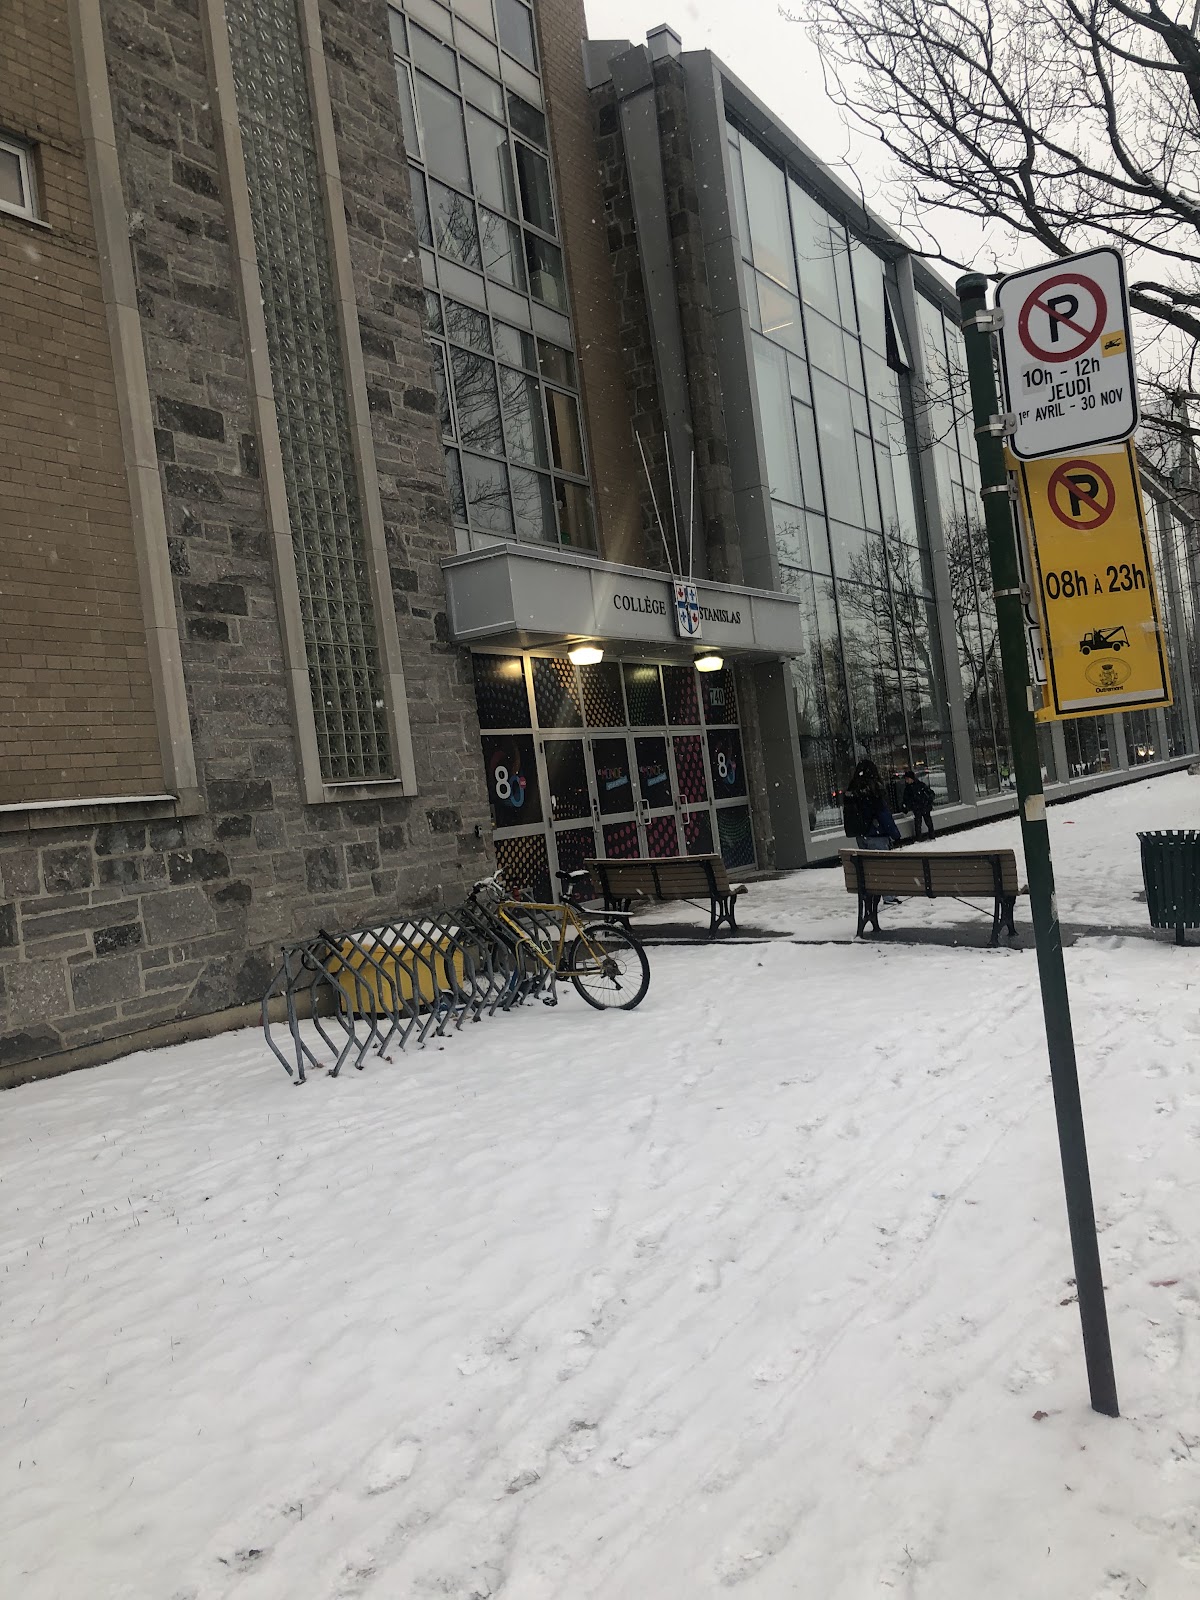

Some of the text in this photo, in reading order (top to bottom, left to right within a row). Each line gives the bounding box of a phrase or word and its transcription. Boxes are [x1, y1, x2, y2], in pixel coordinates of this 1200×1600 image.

[1023, 367, 1053, 388] 10h
[1075, 357, 1100, 377] 12h
[1035, 402, 1066, 422] AVRIL
[1081, 394, 1096, 411] 30
[1100, 387, 1123, 407] NOV
[1047, 376, 1092, 402] JEUDI
[1046, 563, 1146, 600] 08h À 23h
[613, 594, 741, 625] COLLÈGE STANISLAS
[709, 689, 724, 705] 740
